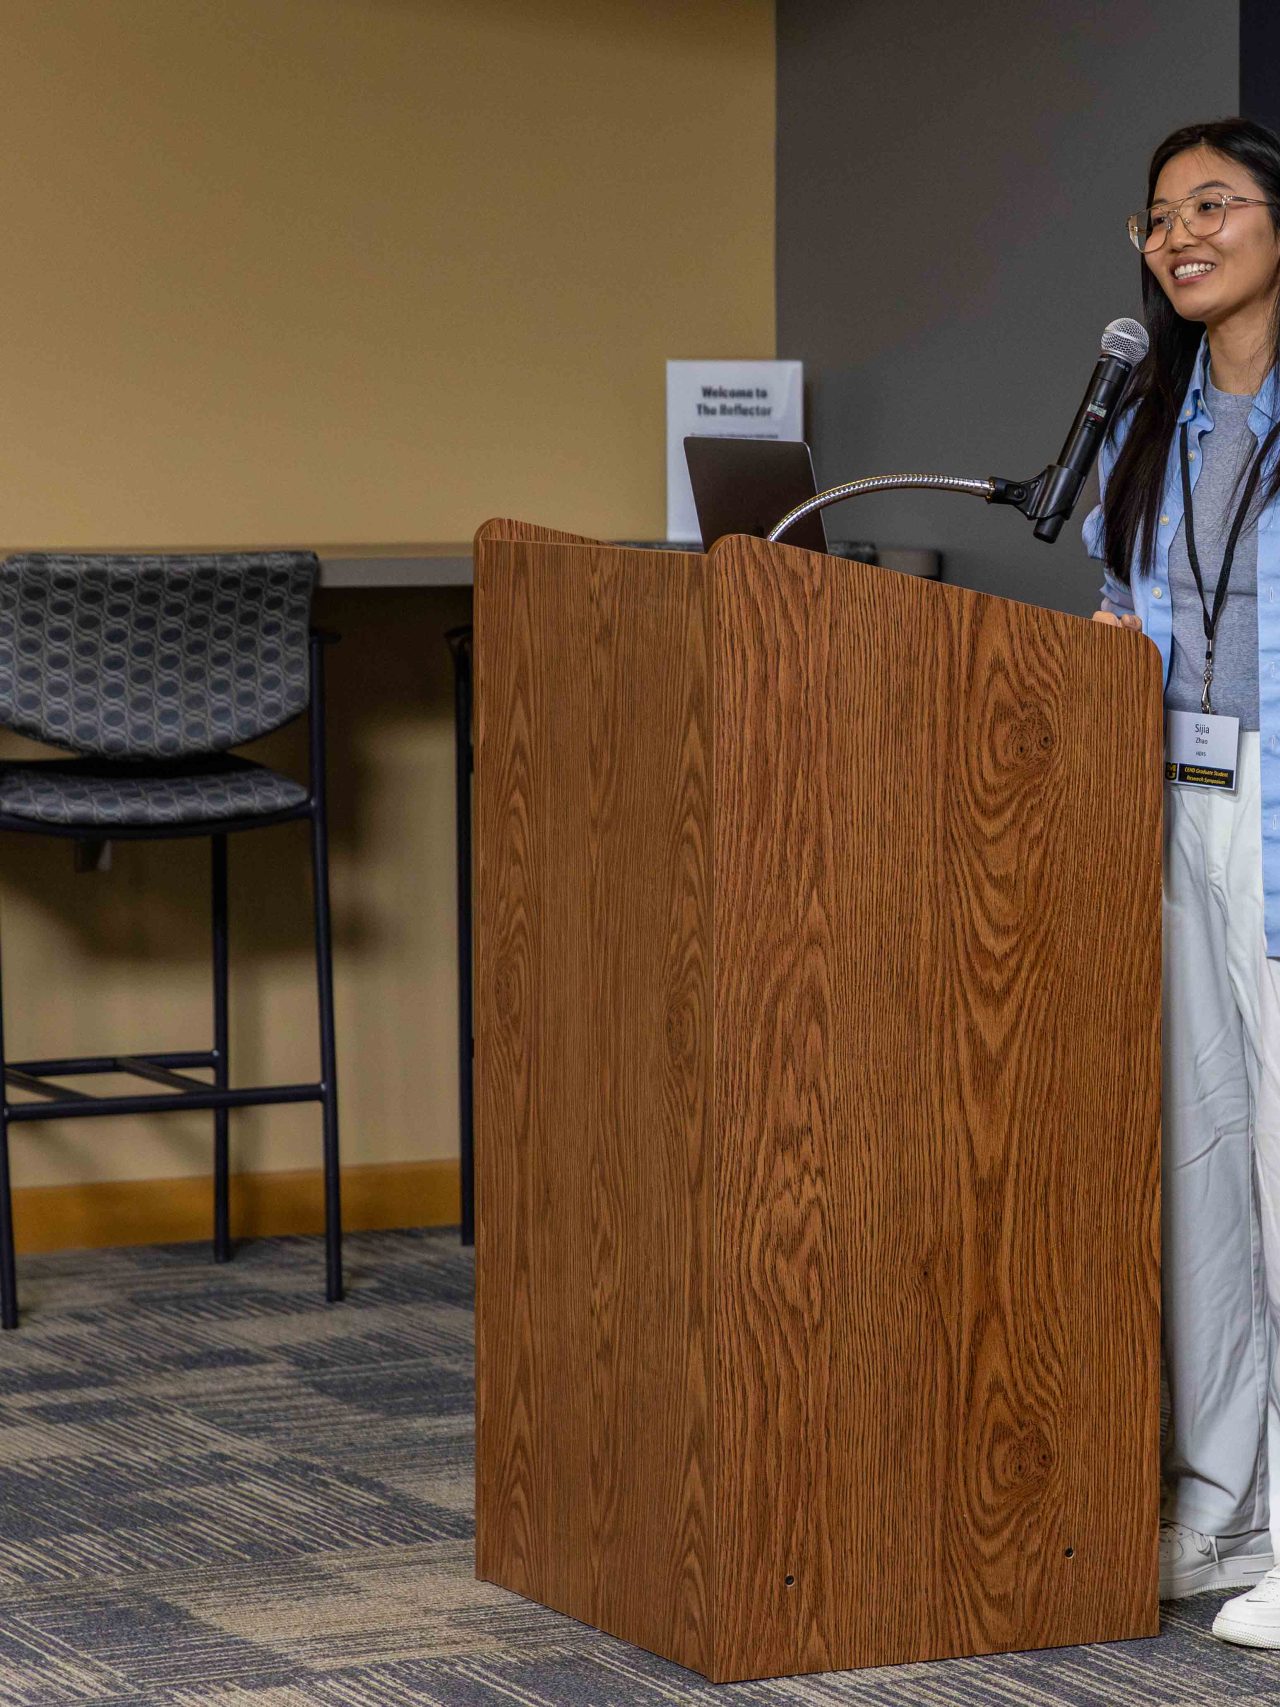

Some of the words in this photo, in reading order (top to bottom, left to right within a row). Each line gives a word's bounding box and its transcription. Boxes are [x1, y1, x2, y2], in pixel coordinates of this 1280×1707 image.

[702, 386, 753, 398] Welcome
[756, 388, 767, 398] to
[697, 404, 717, 415] The
[720, 403, 771, 415] Reflector
[1195, 723, 1210, 735] Sijia
